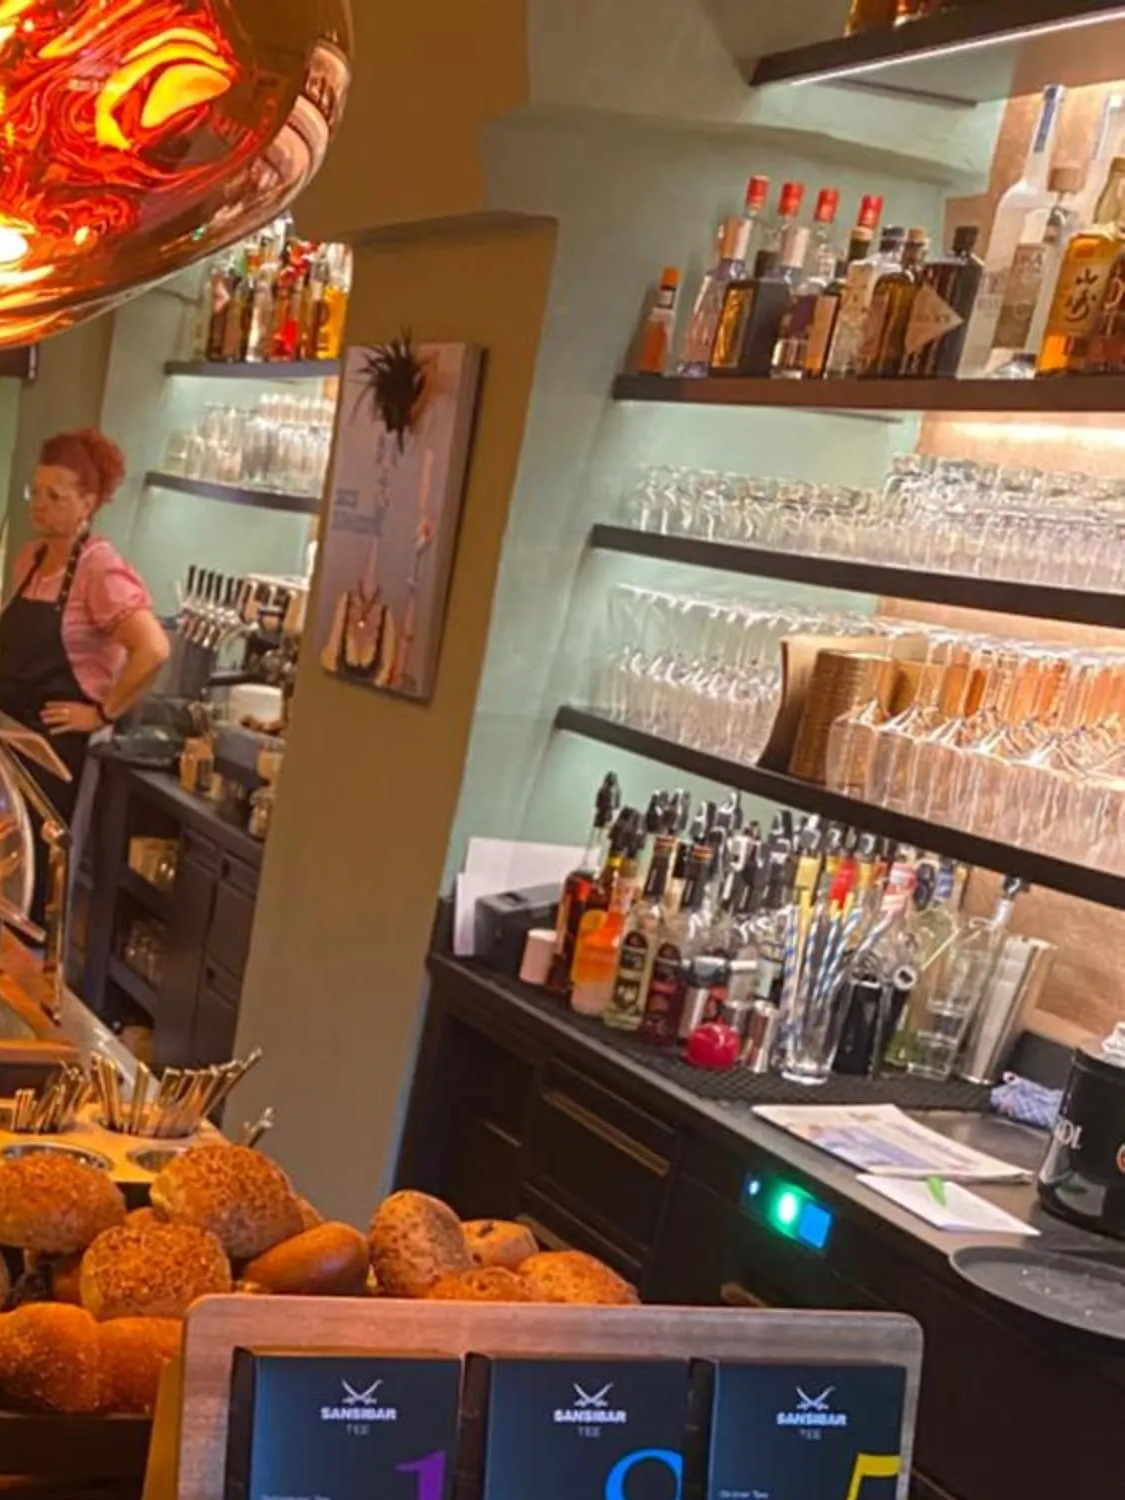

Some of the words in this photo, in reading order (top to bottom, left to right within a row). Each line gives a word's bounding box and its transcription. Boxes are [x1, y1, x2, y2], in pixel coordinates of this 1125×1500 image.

[320, 1407, 397, 1422] SANSIBAR
[553, 1409, 627, 1424] SANSIBAR
[776, 1412, 848, 1427] SANSIBAR
[577, 1427, 601, 1438] TEE
